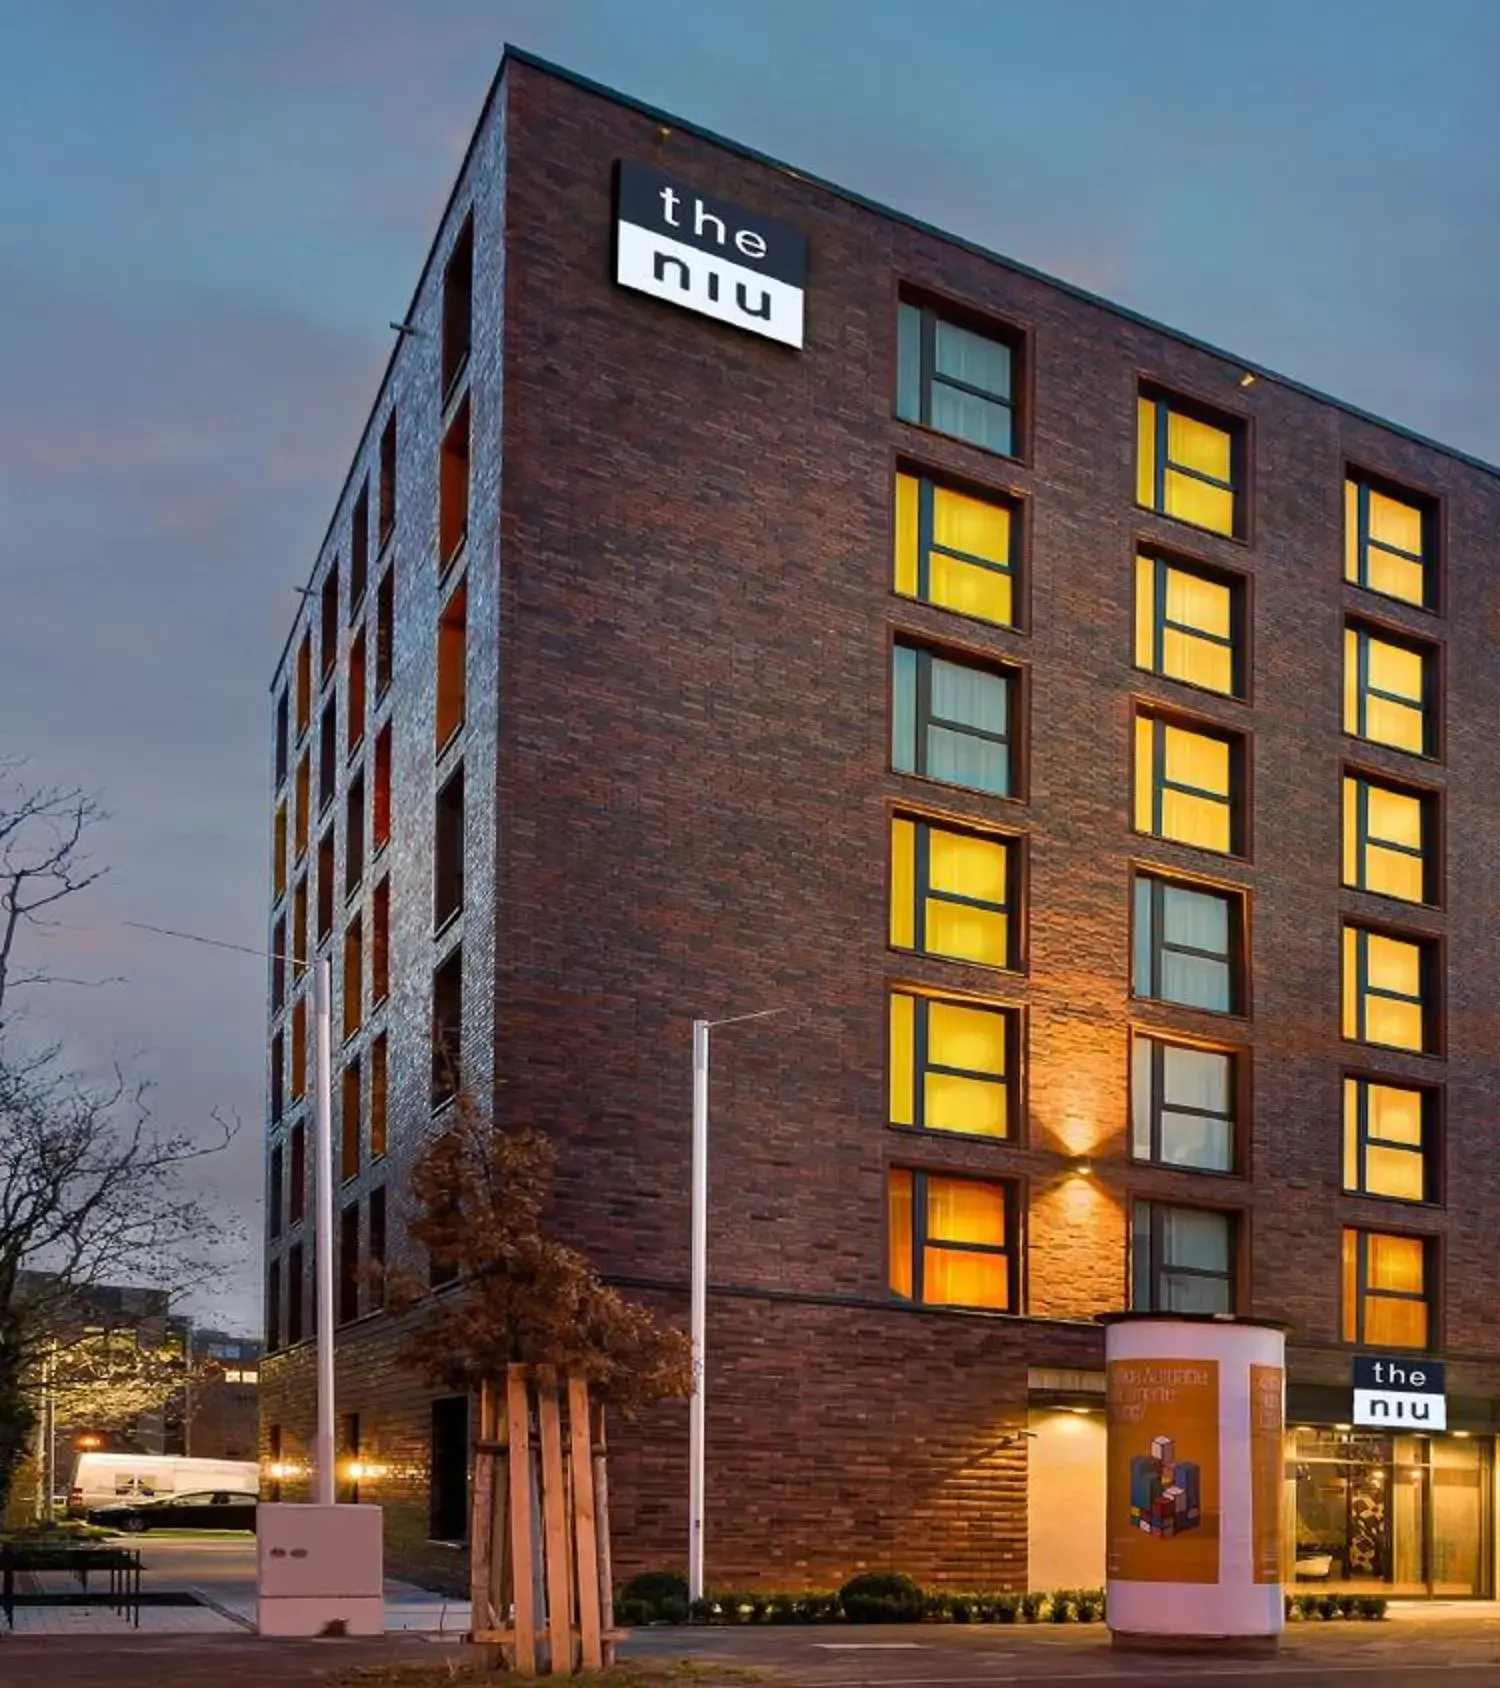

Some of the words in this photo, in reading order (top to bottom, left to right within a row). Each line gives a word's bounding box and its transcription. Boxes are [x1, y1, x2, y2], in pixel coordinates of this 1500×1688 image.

[659, 186, 768, 259] the
[653, 250, 772, 321] niu
[1371, 1361, 1427, 1387] the
[1369, 1398, 1430, 1421] niu
